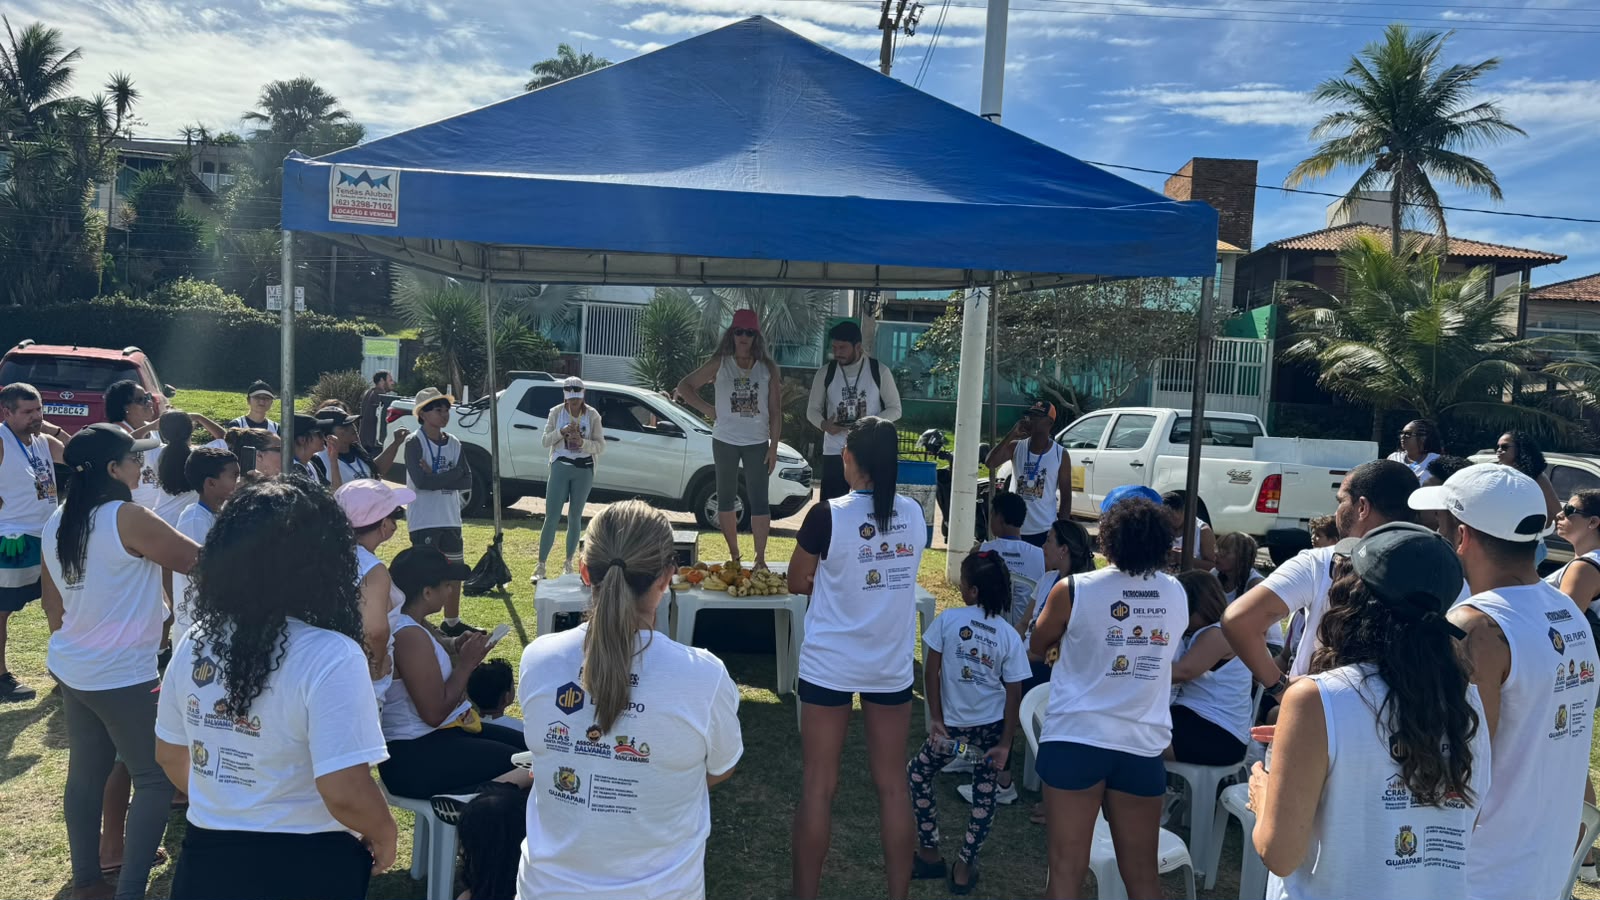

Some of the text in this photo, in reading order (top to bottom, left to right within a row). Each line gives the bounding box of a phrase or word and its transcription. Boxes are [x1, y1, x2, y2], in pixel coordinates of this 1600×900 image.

[336, 187, 393, 198] Tendas Aluban
[335, 208, 363, 217] LOCAÇÃO
[268, 287, 304, 295] VEO
[48, 406, 85, 415] PPC8C42
[546, 733, 570, 742] CRAS
[576, 740, 611, 749] ASSOCIAÇÃO
[574, 745, 612, 756] SALVAMAR
[548, 789, 586, 804] GUARAPARI
